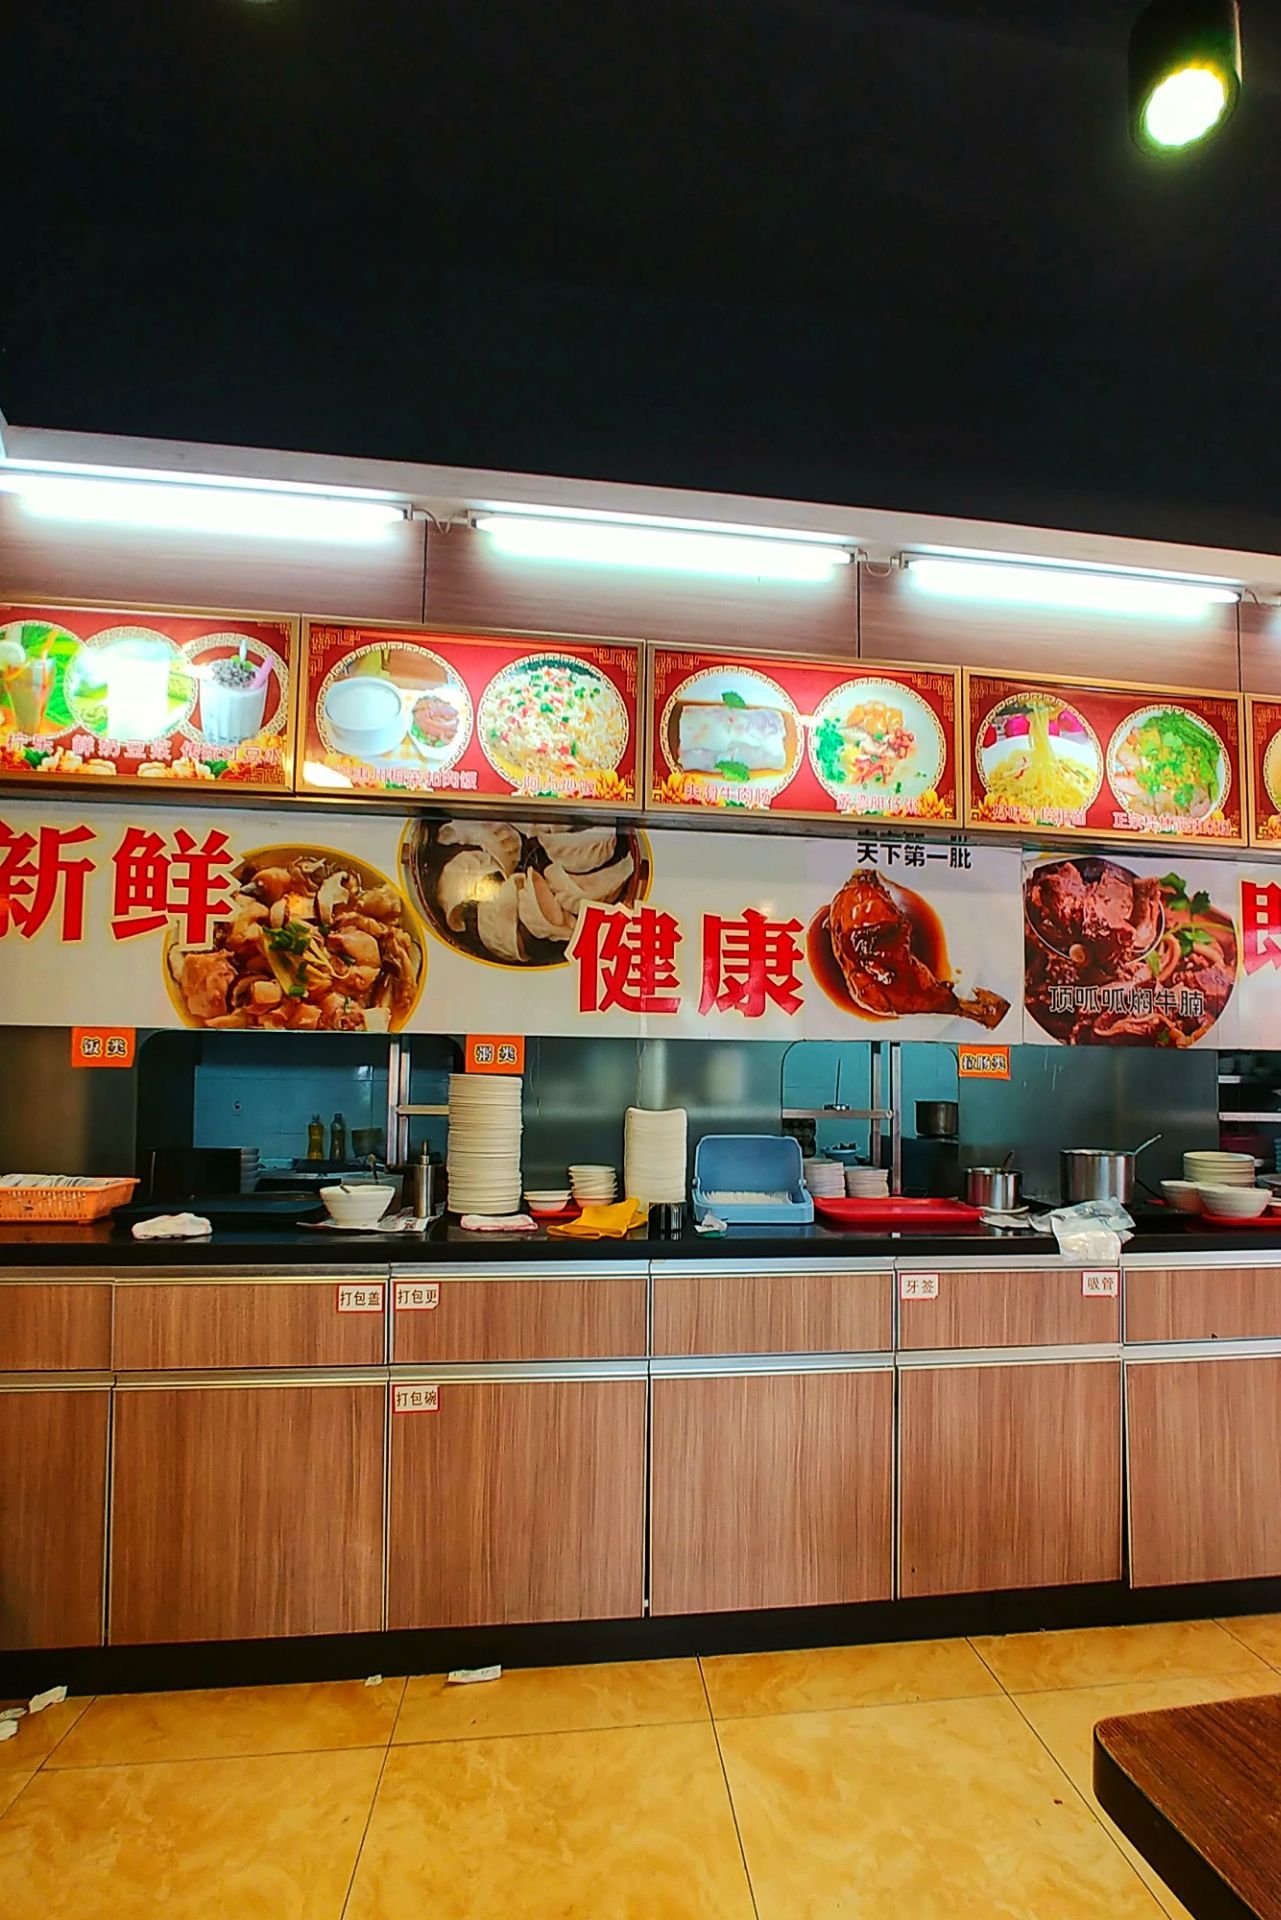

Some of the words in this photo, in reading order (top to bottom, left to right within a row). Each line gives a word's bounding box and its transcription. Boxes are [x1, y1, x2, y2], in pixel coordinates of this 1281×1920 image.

[0, 820, 234, 944] 新鲜
[572, 907, 805, 1017] 健康
[1049, 986, 1205, 1016] 顶呱呱焖牛腩
[82, 1036, 128, 1057] 饭类
[906, 1279, 934, 1294] 牙签
[1087, 1276, 1115, 1291] 吸管
[340, 1291, 380, 1306] 打包盖
[396, 1390, 437, 1407] 打包碗
